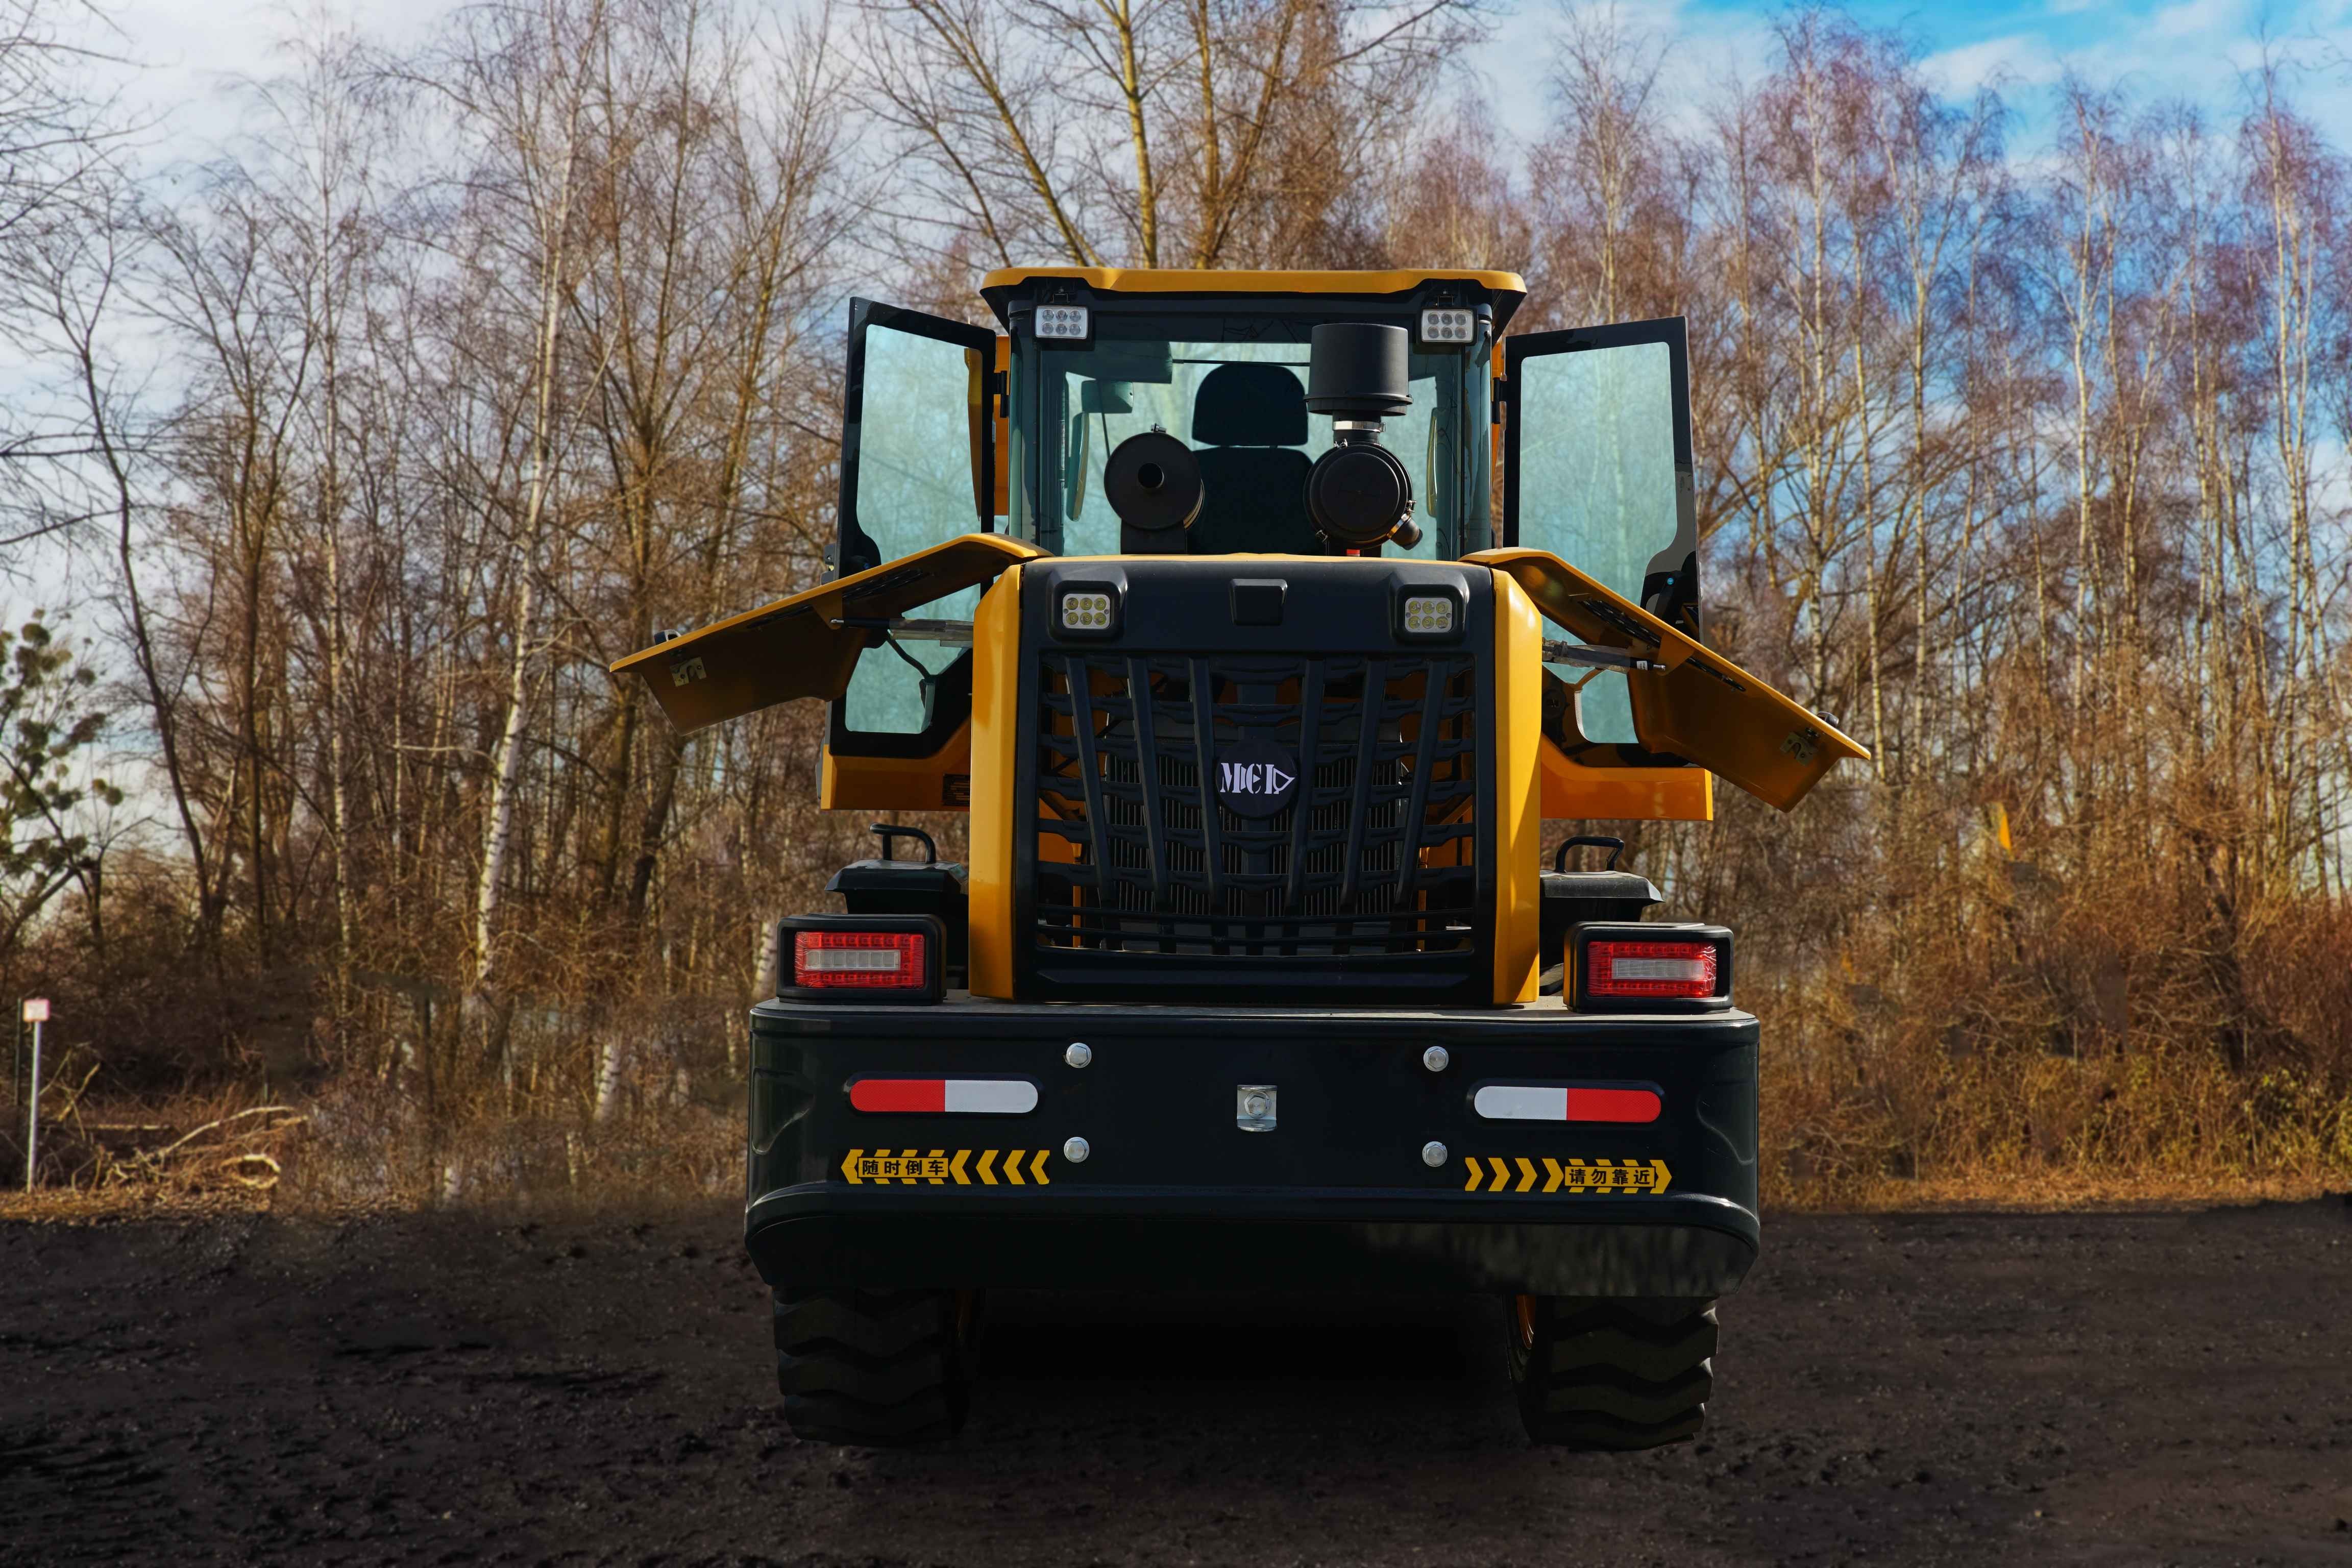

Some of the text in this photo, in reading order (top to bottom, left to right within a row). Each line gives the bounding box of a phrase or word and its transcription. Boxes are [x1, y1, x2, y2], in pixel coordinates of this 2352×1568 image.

[862, 1159, 945, 1176] 随时倒车
[1569, 1168, 1651, 1185] 请勿靠近
